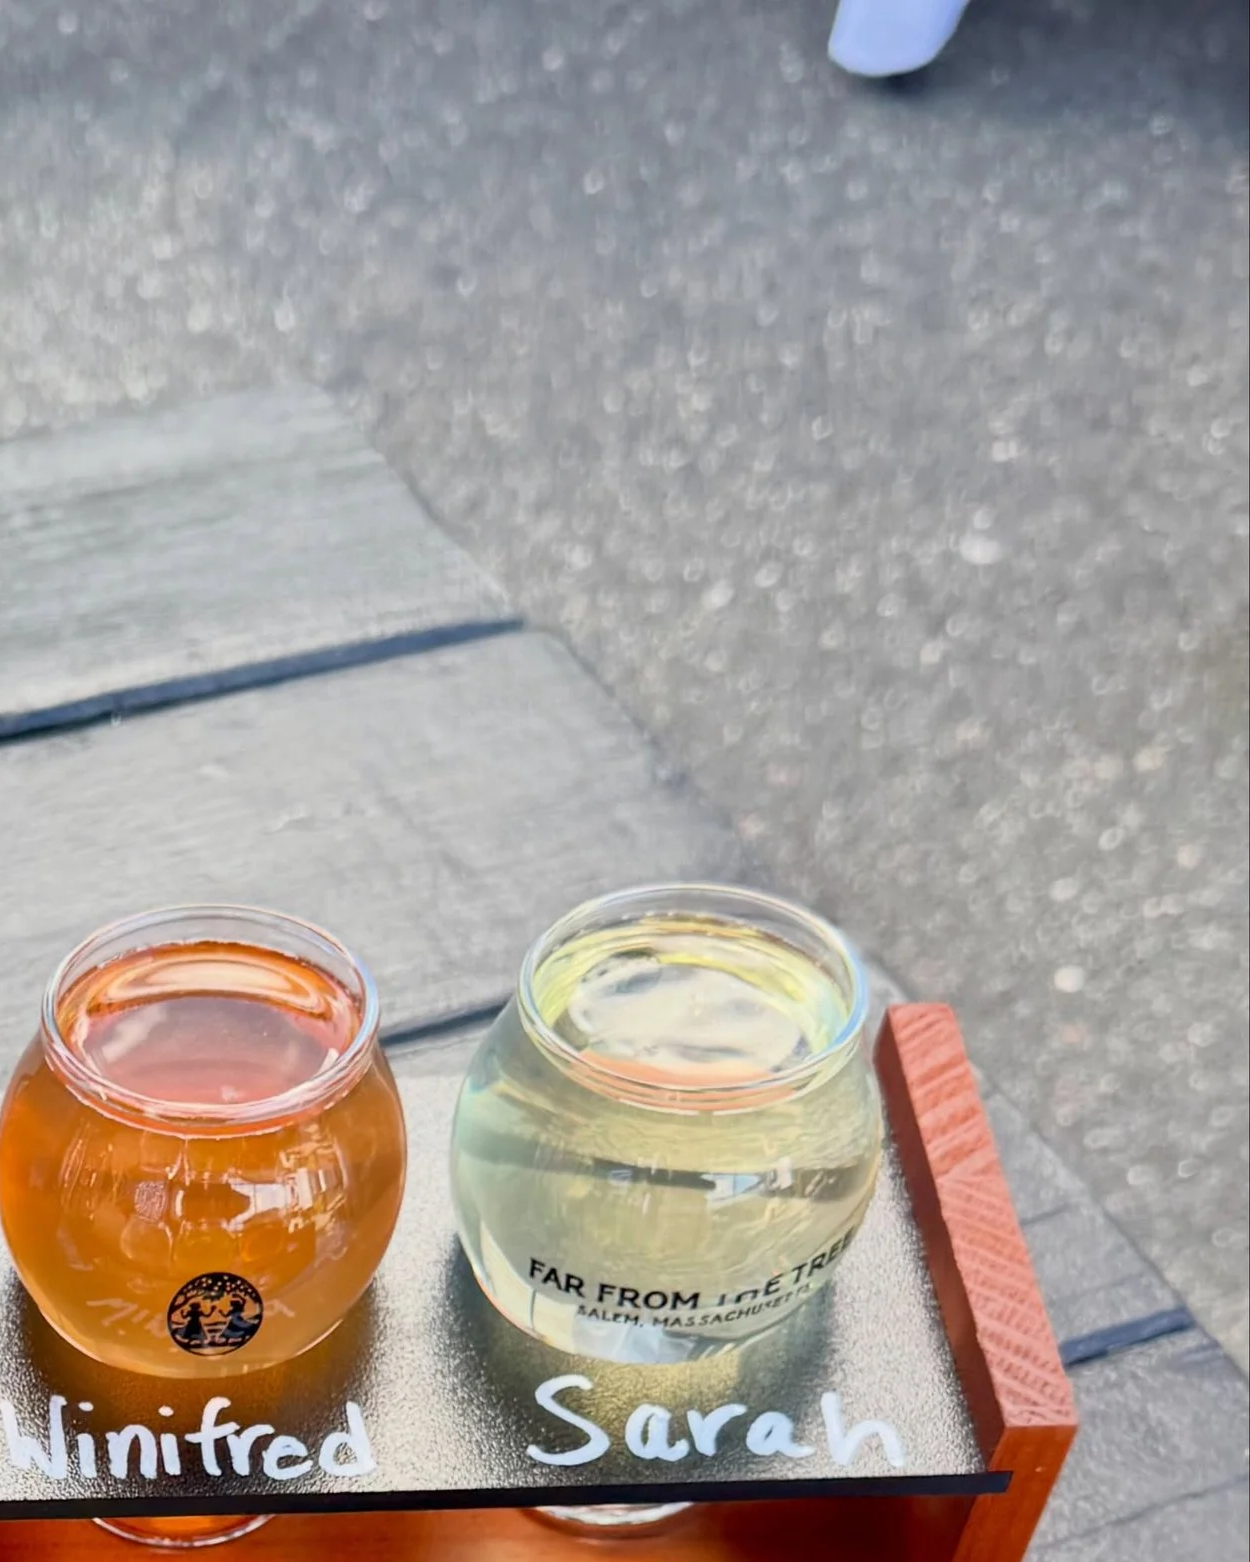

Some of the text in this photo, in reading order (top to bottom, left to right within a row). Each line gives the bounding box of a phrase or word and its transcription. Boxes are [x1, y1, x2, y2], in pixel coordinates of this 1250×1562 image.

[529, 1257, 586, 1298] FAR
[597, 1282, 702, 1311] FROM
[576, 1304, 645, 1328] SALEM,
[0, 1394, 378, 1482] Winifred
[526, 1373, 906, 1469] Sarah
